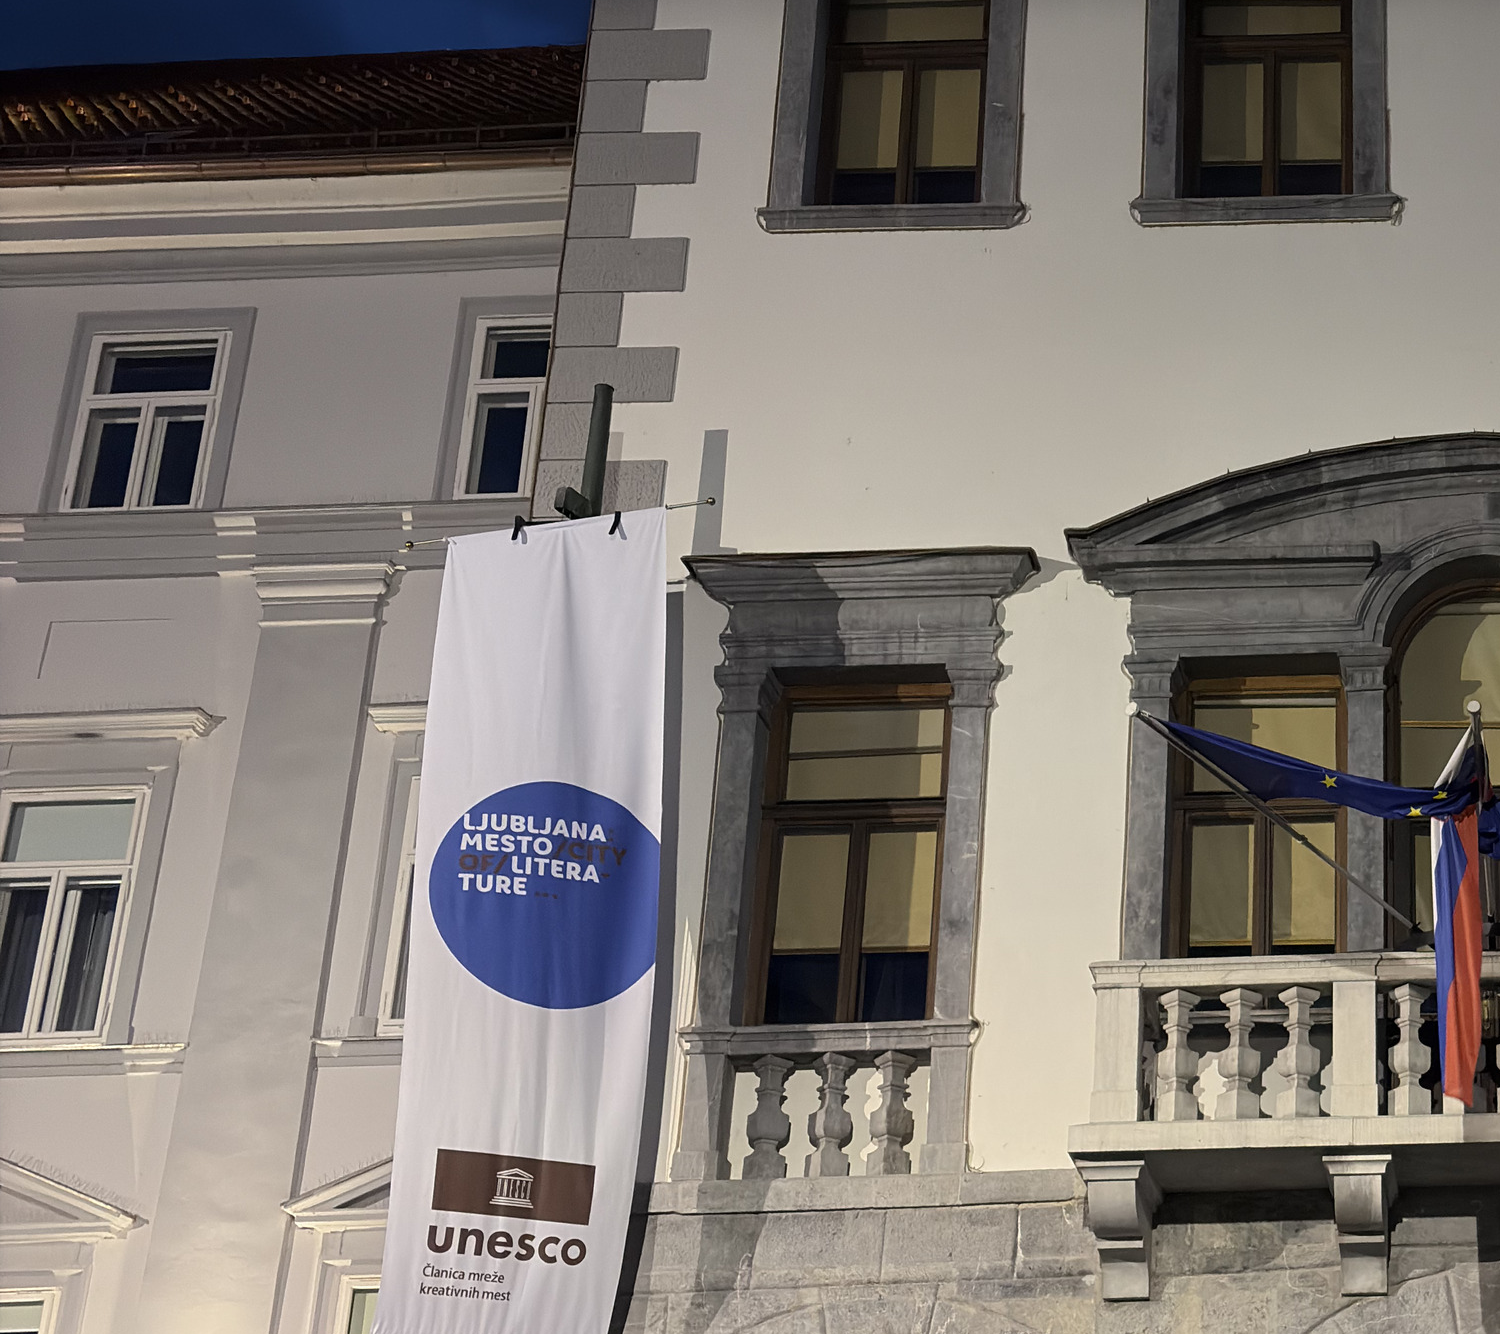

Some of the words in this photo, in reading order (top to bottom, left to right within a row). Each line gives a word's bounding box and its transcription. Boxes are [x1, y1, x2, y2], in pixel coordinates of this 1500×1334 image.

[458, 873, 528, 896] TURE
[427, 1225, 587, 1266] unesco
[422, 1262, 466, 1282] Članica
[468, 1268, 506, 1283] mreže
[419, 1283, 480, 1299] kreativnih
[481, 1288, 511, 1301] mest
